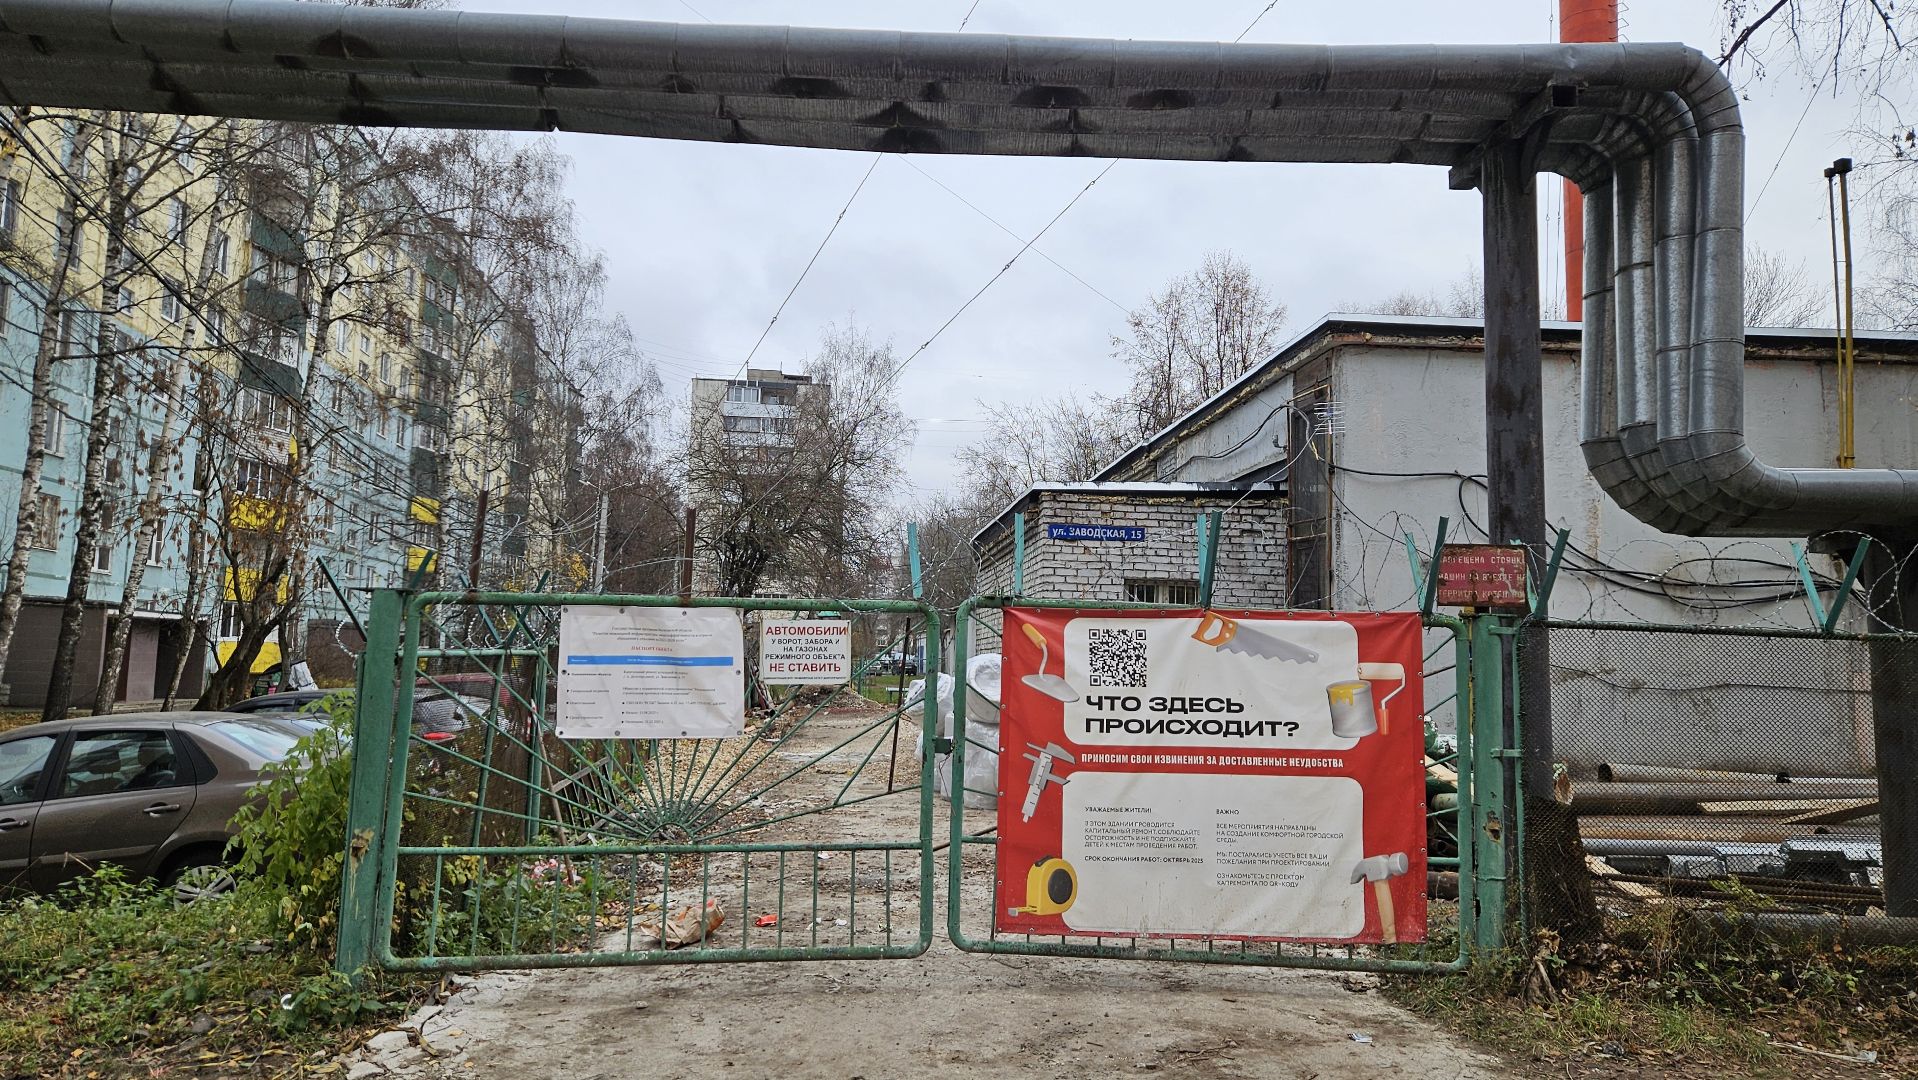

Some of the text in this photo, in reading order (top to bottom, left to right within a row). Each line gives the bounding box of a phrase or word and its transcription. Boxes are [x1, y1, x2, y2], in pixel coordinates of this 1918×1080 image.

[1052, 527, 1142, 540] ул. ЗАВОДСКАЯ, 15
[1438, 556, 1485, 565] АПРЕЩЕНА
[766, 626, 848, 636] АВТОМОБИЛИ
[769, 663, 841, 672] НЕ СТАВИТЬ
[1086, 695, 1245, 715] ЧТО ЗДЕСЬ
[1085, 717, 1300, 738] ПРОИСХОДИТ?
[1081, 753, 1344, 768] ПРИНОСИМ СВОИ ИЗВИНЕНИЯ ЗА ДОСТАВЛЕННЫЕ НЕУДОБСТВА
